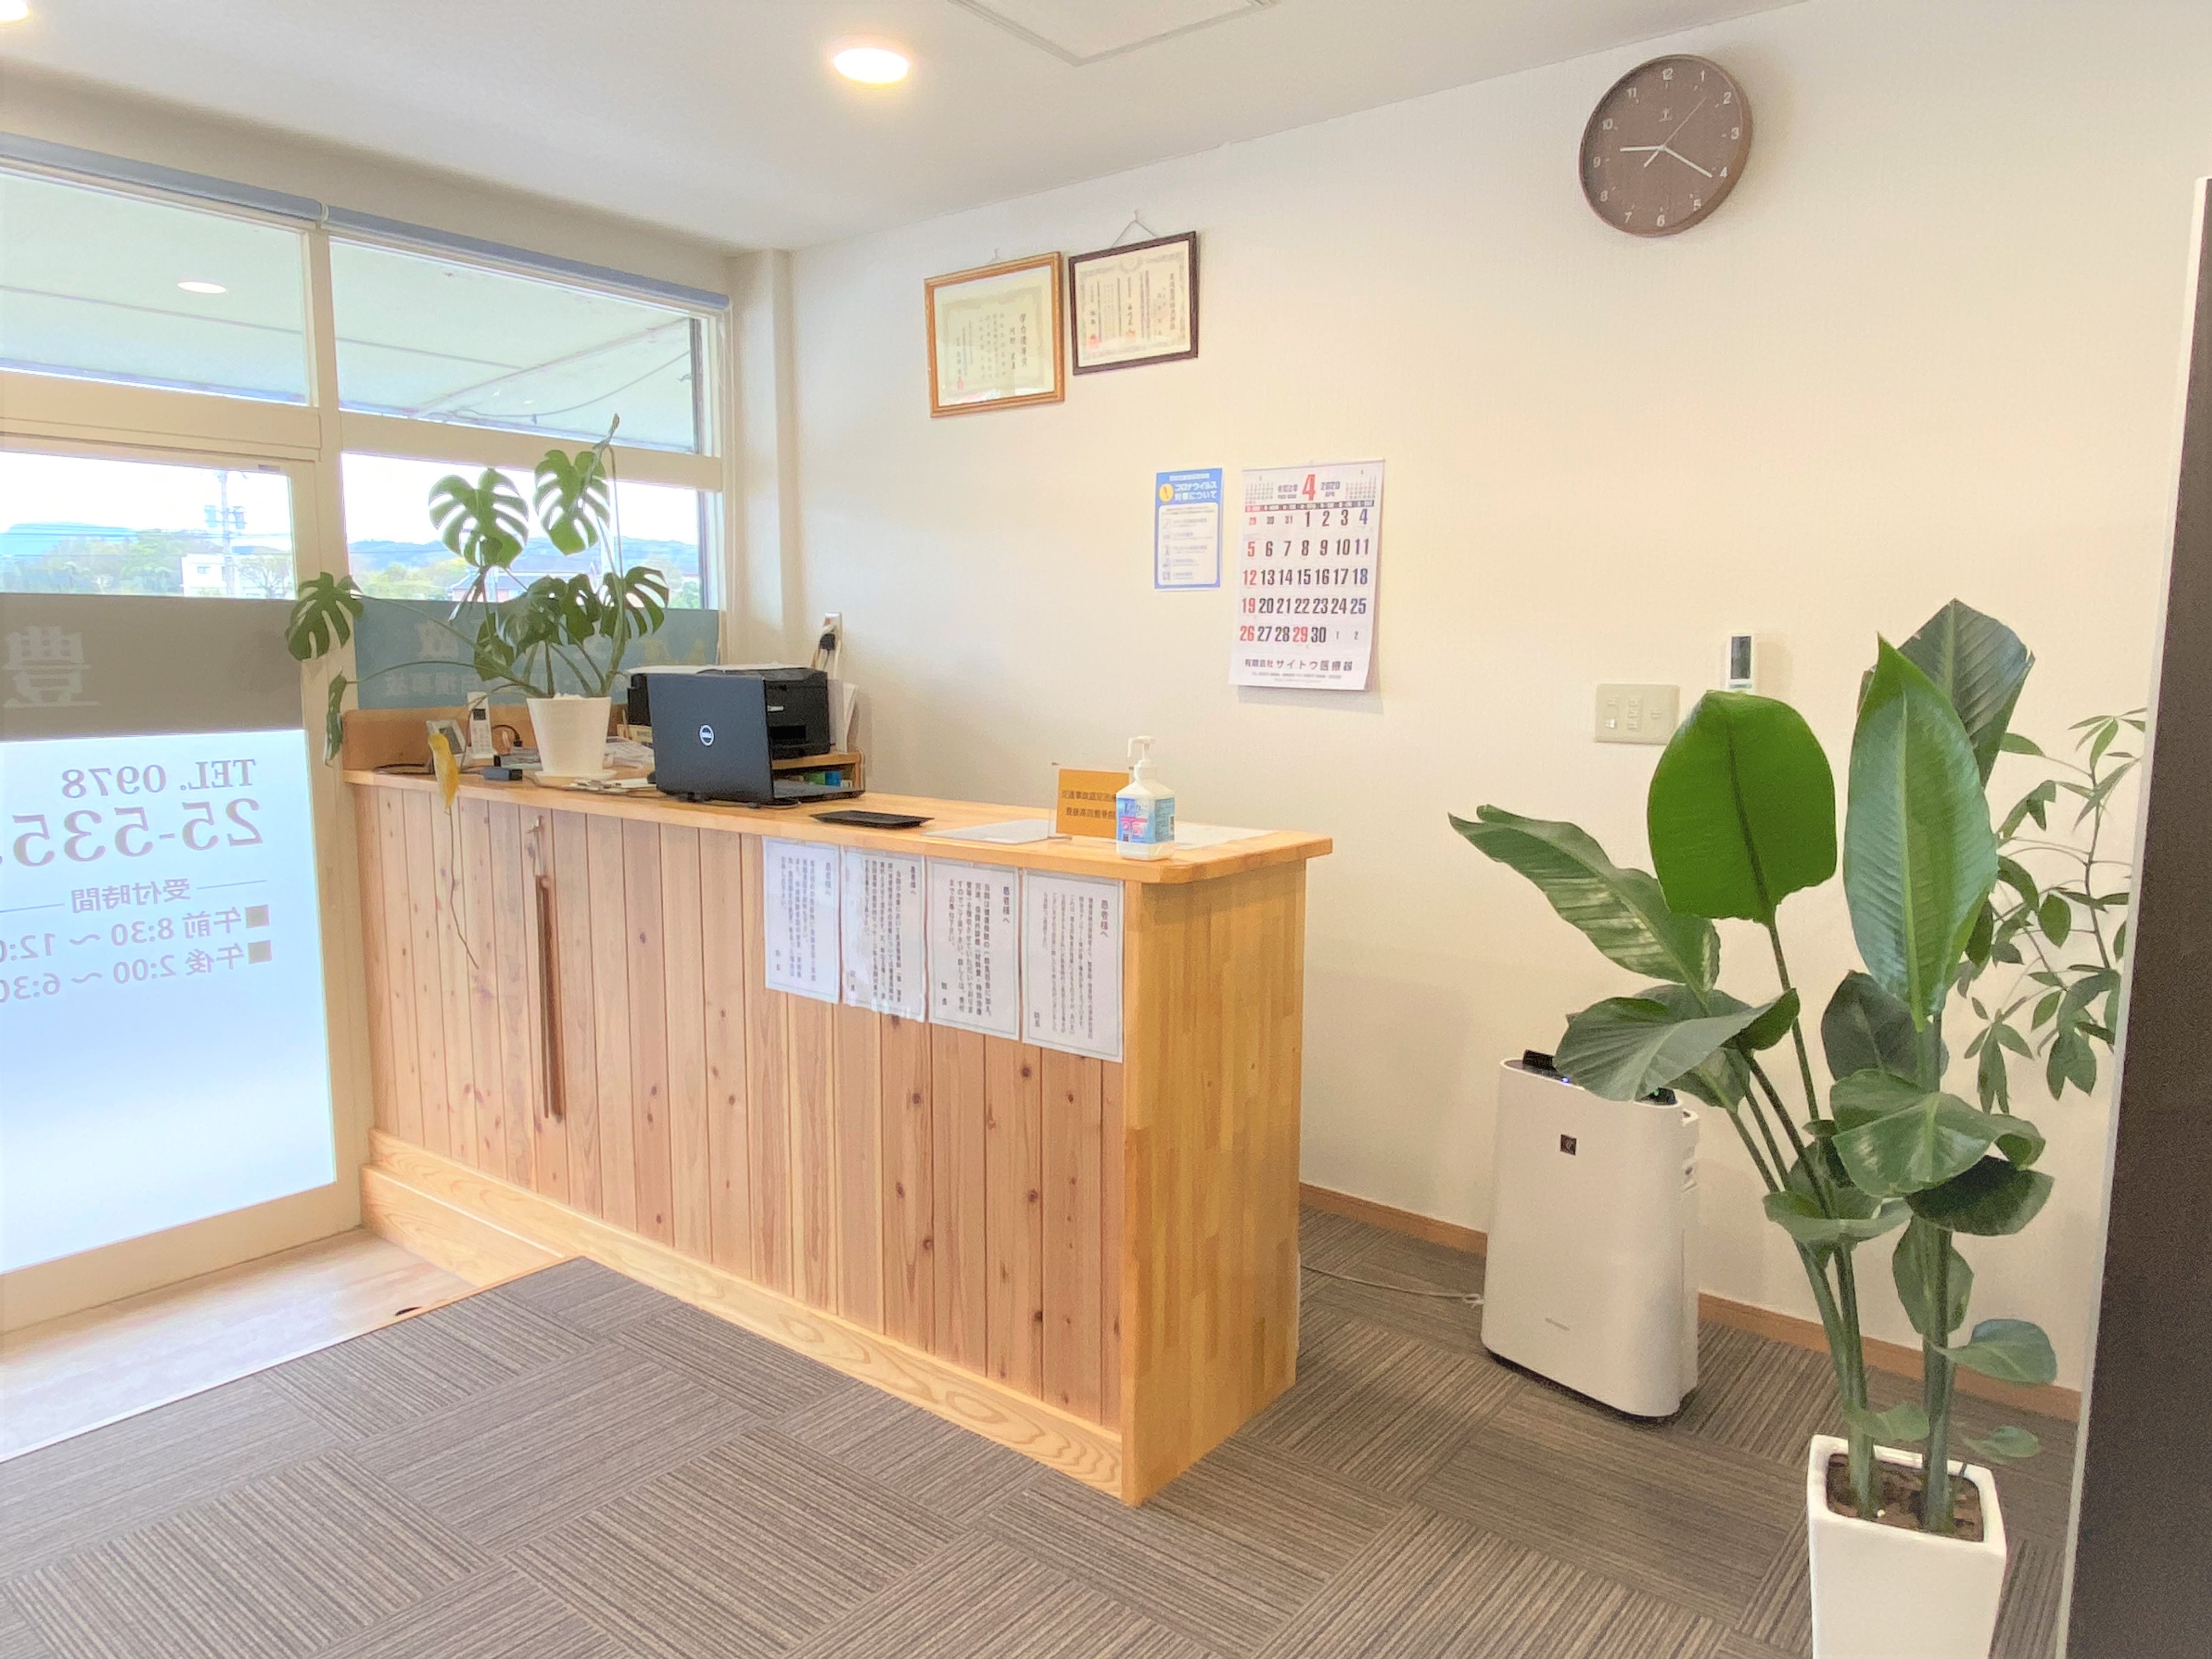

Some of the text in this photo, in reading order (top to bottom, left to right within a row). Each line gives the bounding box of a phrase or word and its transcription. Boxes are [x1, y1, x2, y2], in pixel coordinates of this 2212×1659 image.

[1662, 68, 1673, 81] 12
[1700, 70, 1705, 82] 1
[1627, 88, 1637, 98] 11
[1723, 92, 1732, 104] 2
[1601, 119, 1613, 131] 10
[1731, 127, 1739, 140] 3
[1593, 156, 1601, 168] 9
[1719, 166, 1727, 178] 4
[1600, 190, 1608, 202] 8
[1693, 199, 1702, 211] 5
[1625, 212, 1632, 223] 7
[1657, 215, 1665, 227] 6
[1302, 475, 1316, 501] 4
[1285, 516, 1293, 524] 31
[1305, 511, 1311, 527] 1
[1322, 511, 1330, 527] 2
[1341, 510, 1348, 526] 3
[1359, 509, 1368, 524] 4
[1248, 538, 1369, 557] 5 6 7 8 9 10 11
[1243, 568, 1368, 585] 12 13 14 15 16 17 18
[1242, 597, 1367, 614] 19 20 21 22 23 24 25
[1240, 625, 1359, 643] 26 27 28 29 30 1 2
[1101, 900, 1109, 938] 患者様へ
